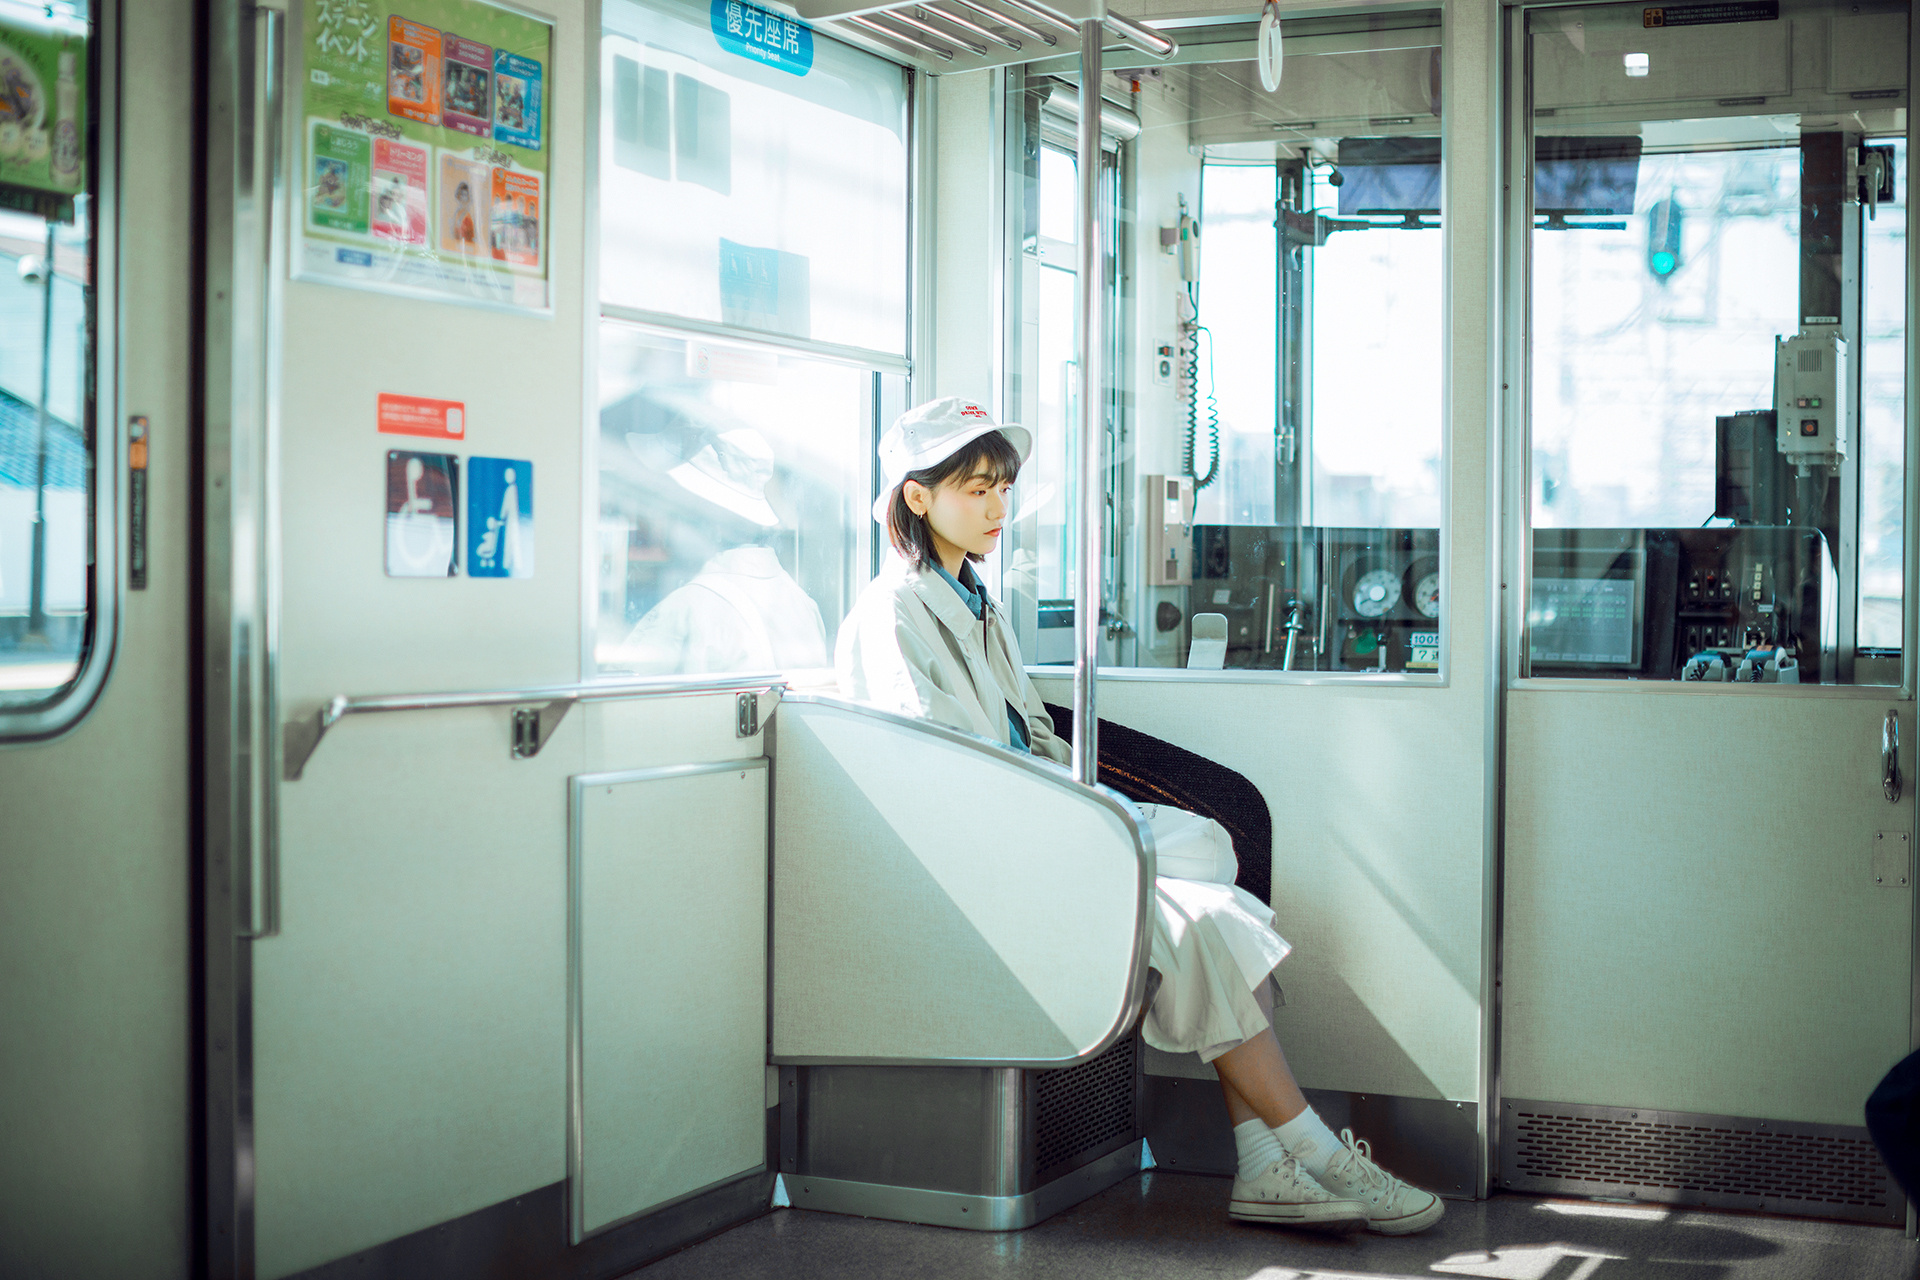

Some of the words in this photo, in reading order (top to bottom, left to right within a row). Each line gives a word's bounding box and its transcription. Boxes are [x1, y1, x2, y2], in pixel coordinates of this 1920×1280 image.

[316, 26, 369, 62] イベント
[725, 1, 800, 55] 優先座席
[745, 41, 767, 60] Priority
[767, 49, 781, 62] Seat
